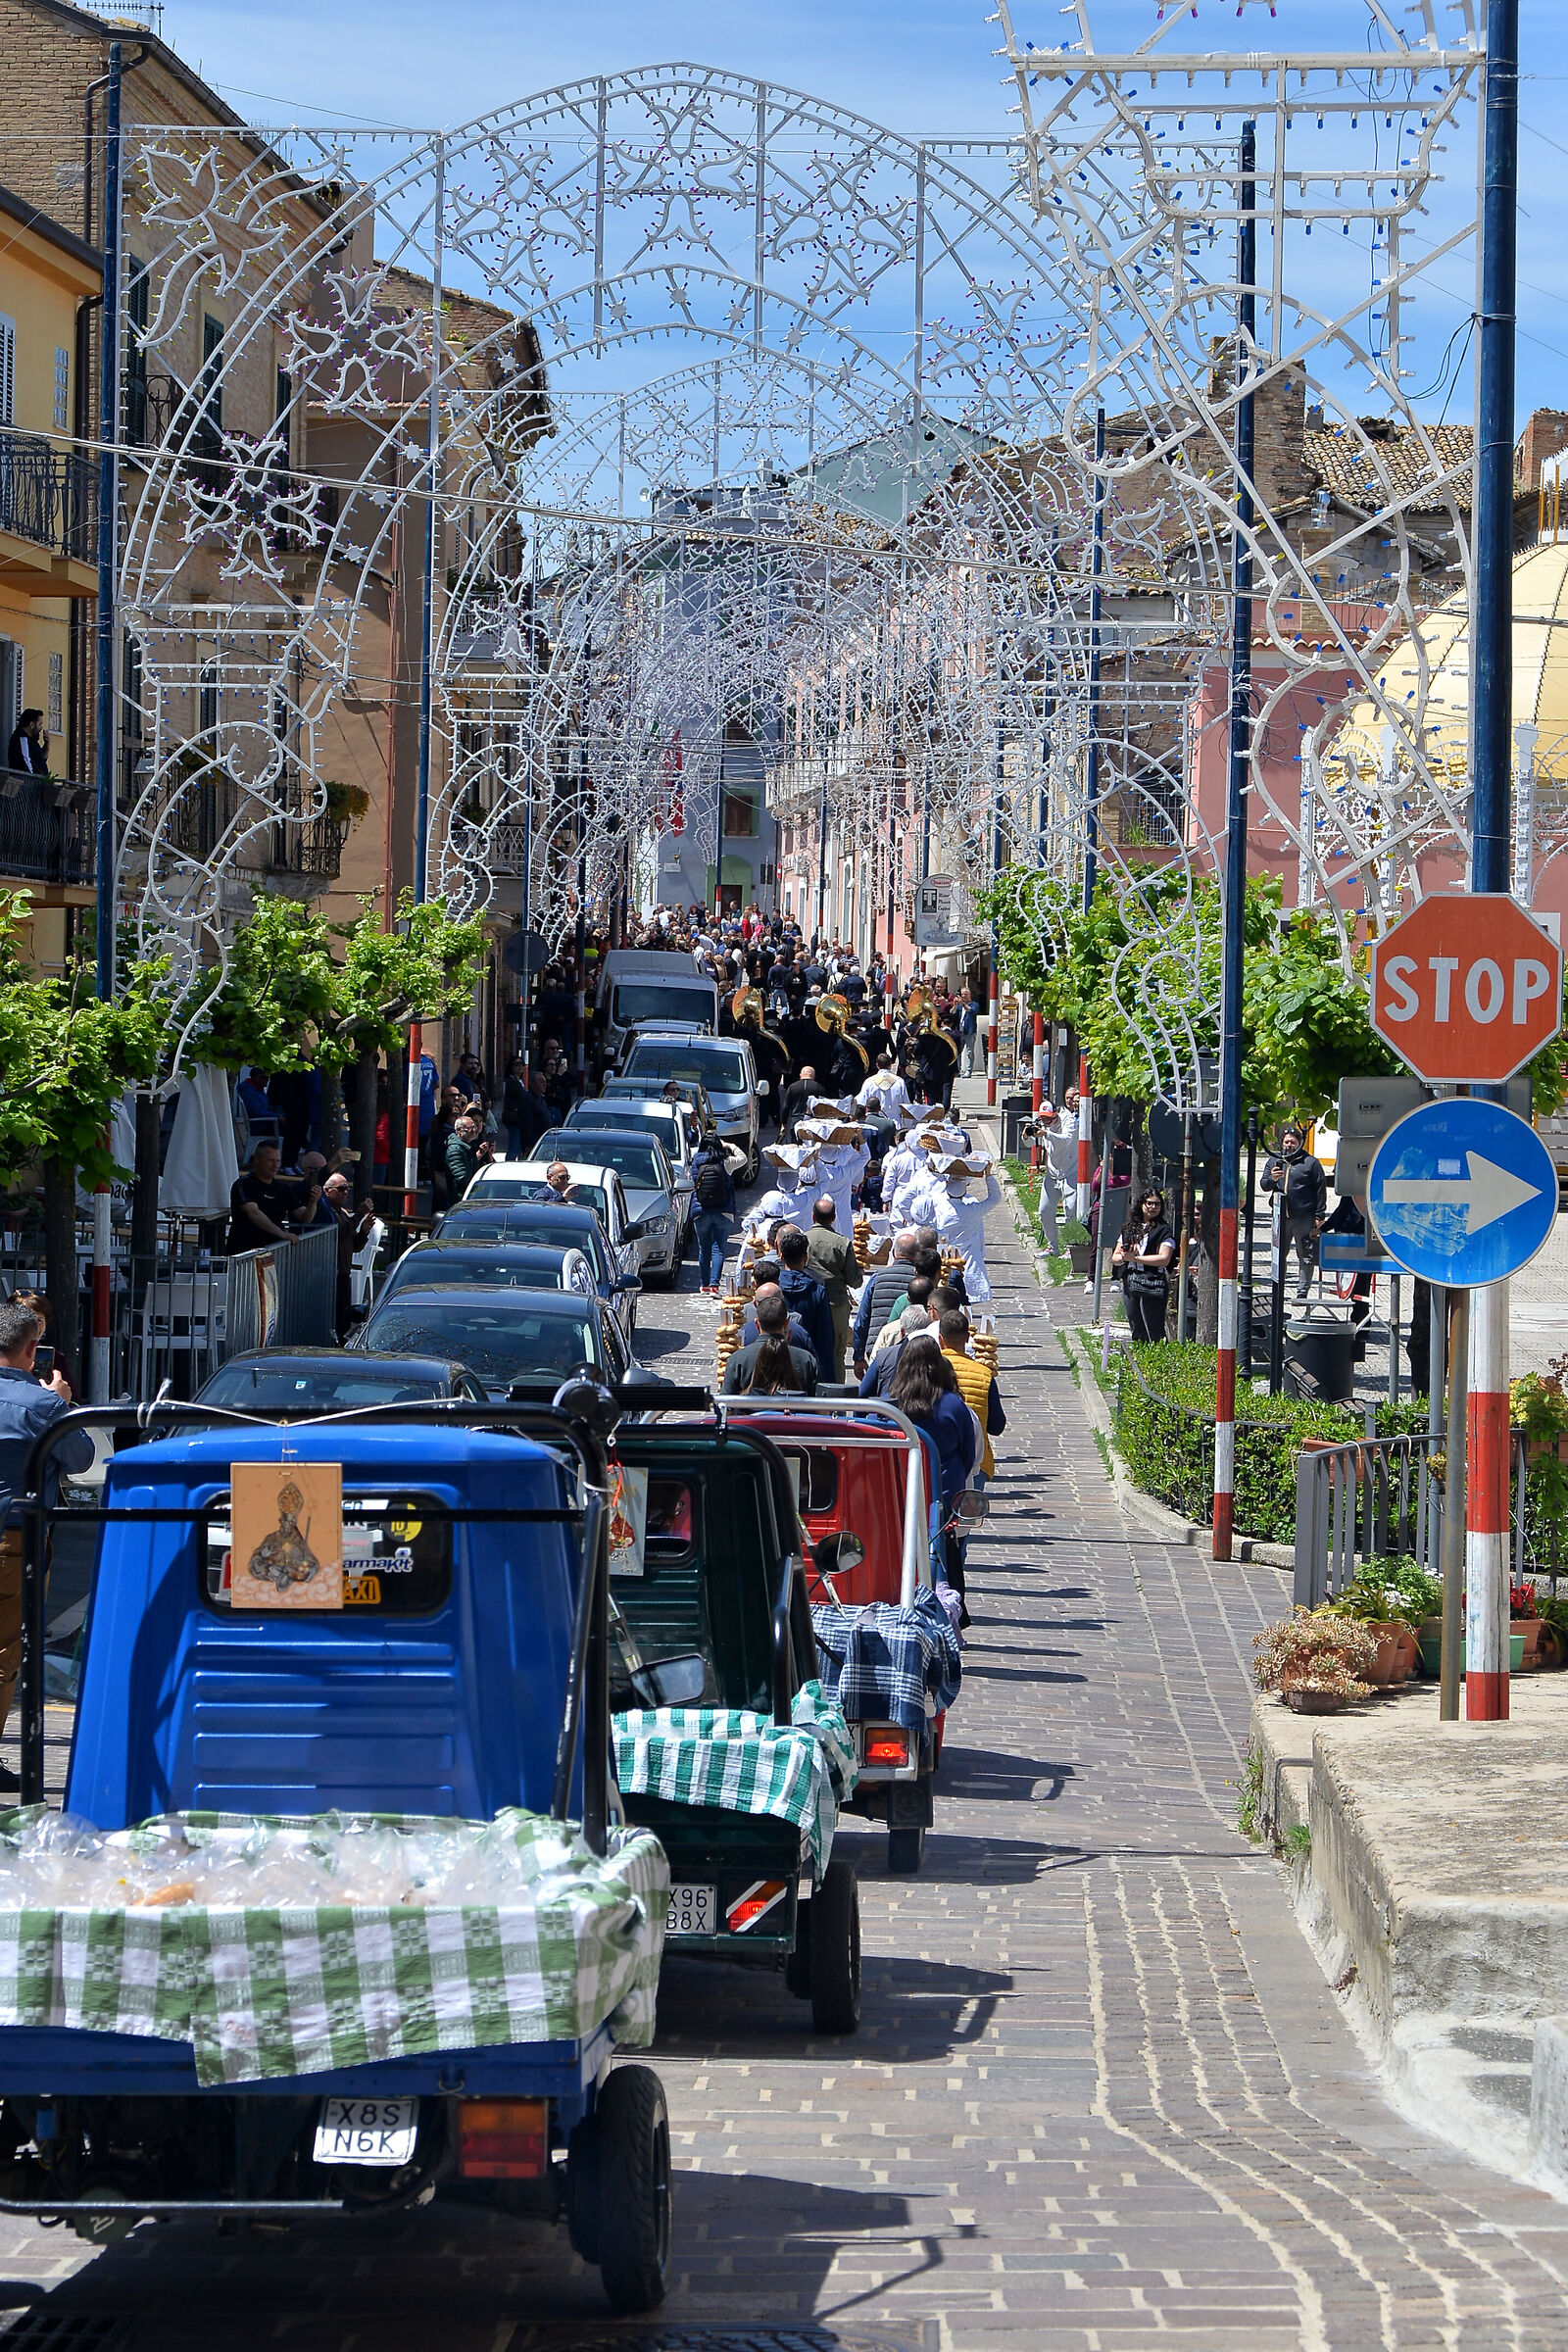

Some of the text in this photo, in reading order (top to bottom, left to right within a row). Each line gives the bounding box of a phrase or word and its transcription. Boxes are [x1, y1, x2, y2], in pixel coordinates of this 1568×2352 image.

[1383, 955, 1550, 1025] STOP
[343, 1556, 411, 1571] armaKit
[343, 1580, 373, 1600] AXI
[668, 1887, 708, 1908] X96
[666, 1910, 707, 1931] B8X
[337, 2102, 400, 2126] X8S
[333, 2129, 395, 2153] N6K
